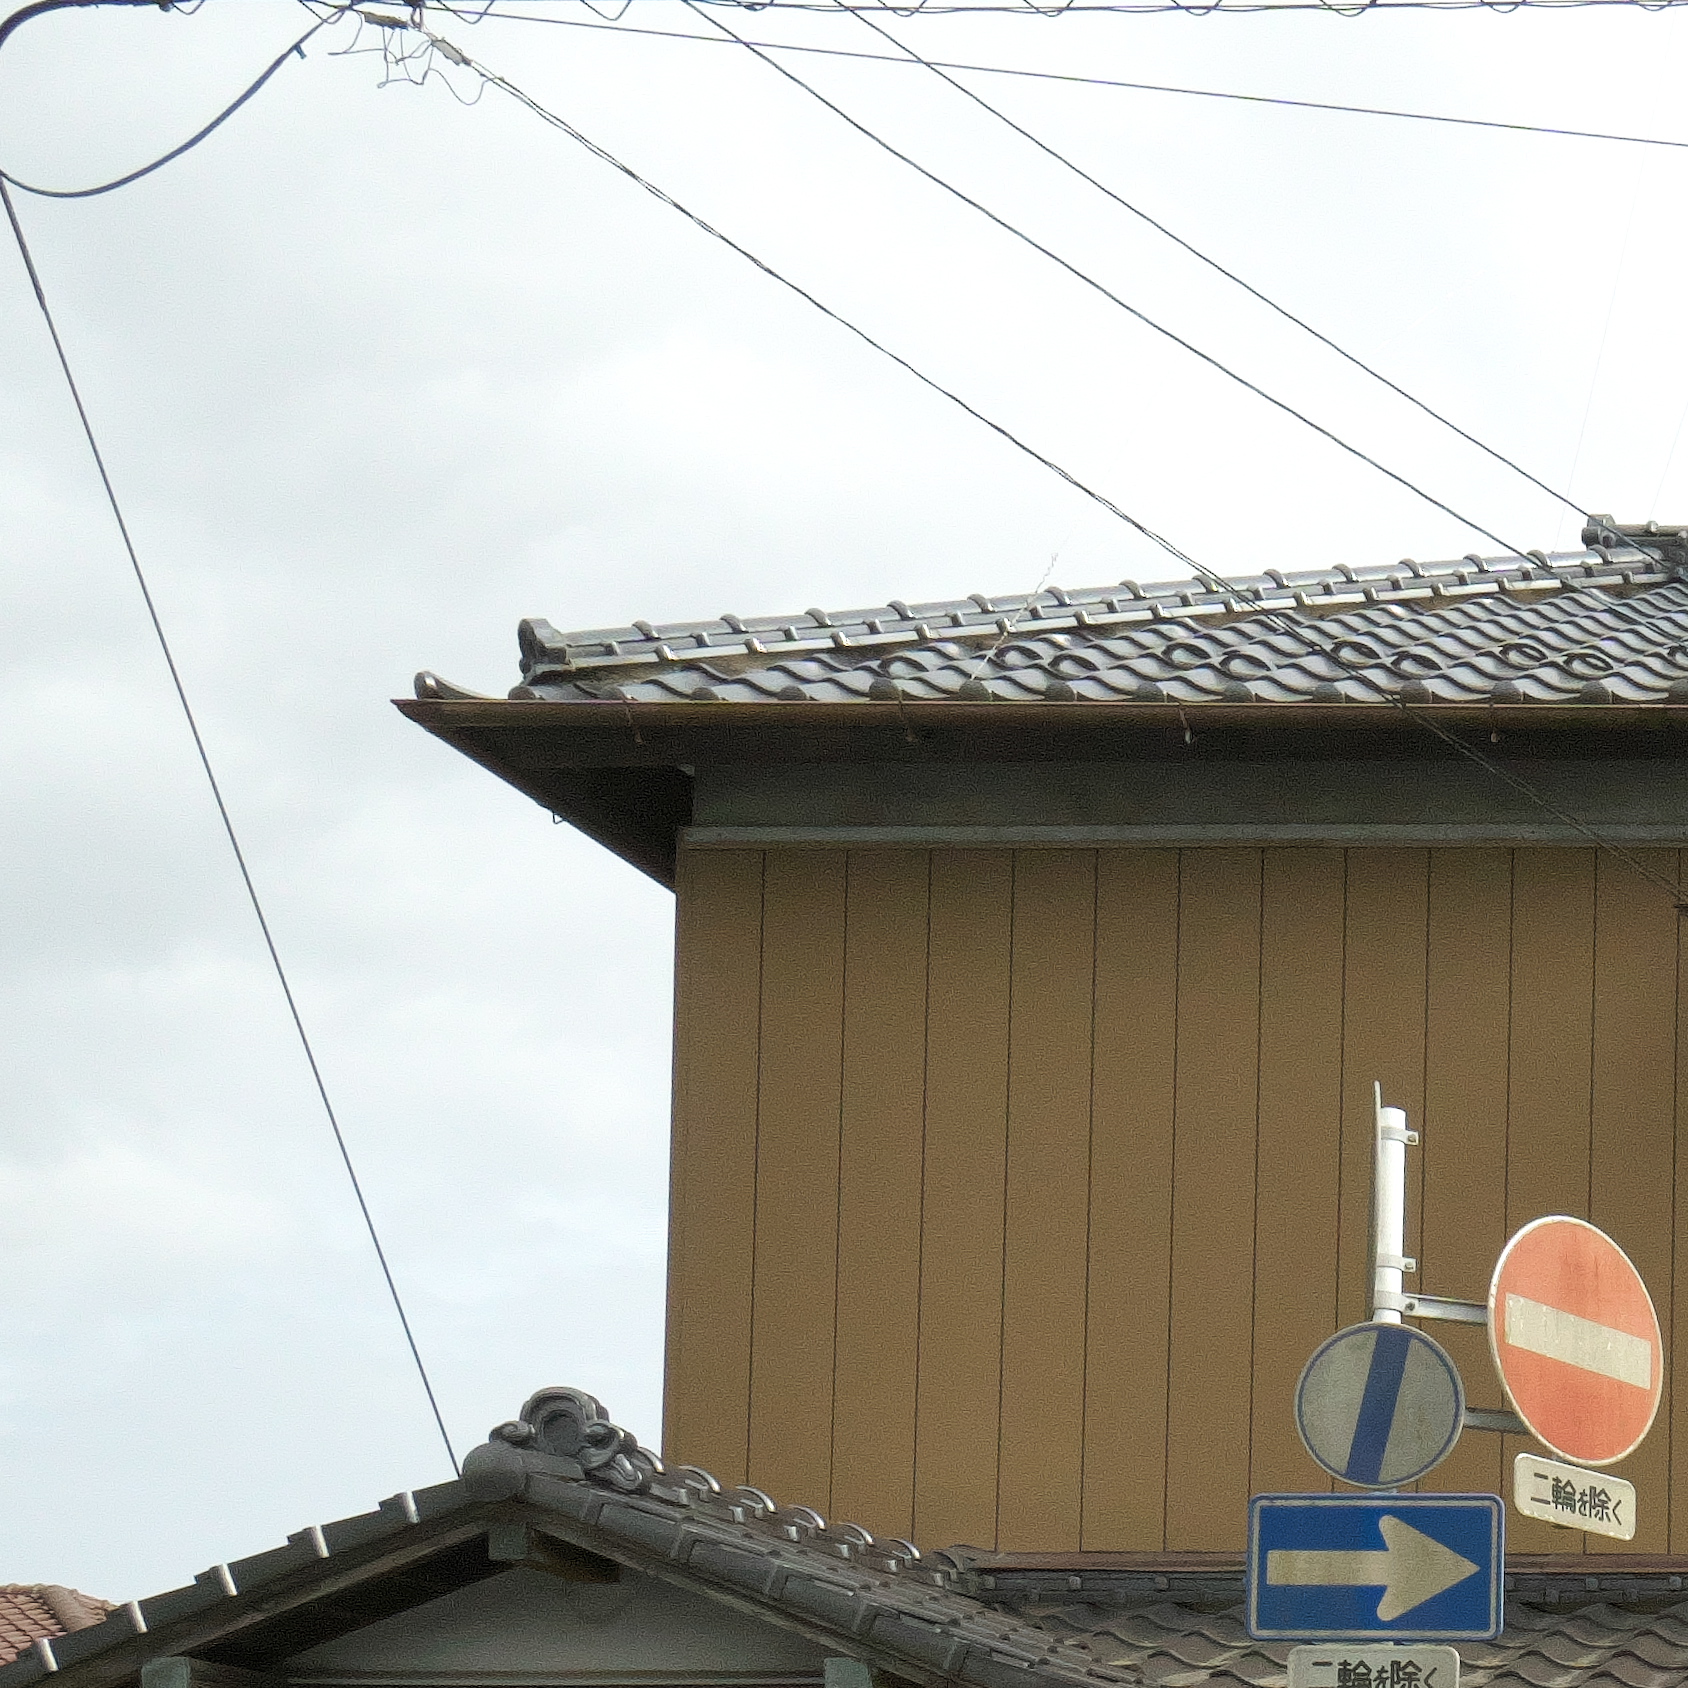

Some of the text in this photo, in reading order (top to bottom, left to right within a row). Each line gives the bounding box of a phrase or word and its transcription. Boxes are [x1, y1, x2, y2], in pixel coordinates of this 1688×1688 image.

[1530, 1472, 1622, 1526] 二輪を除く
